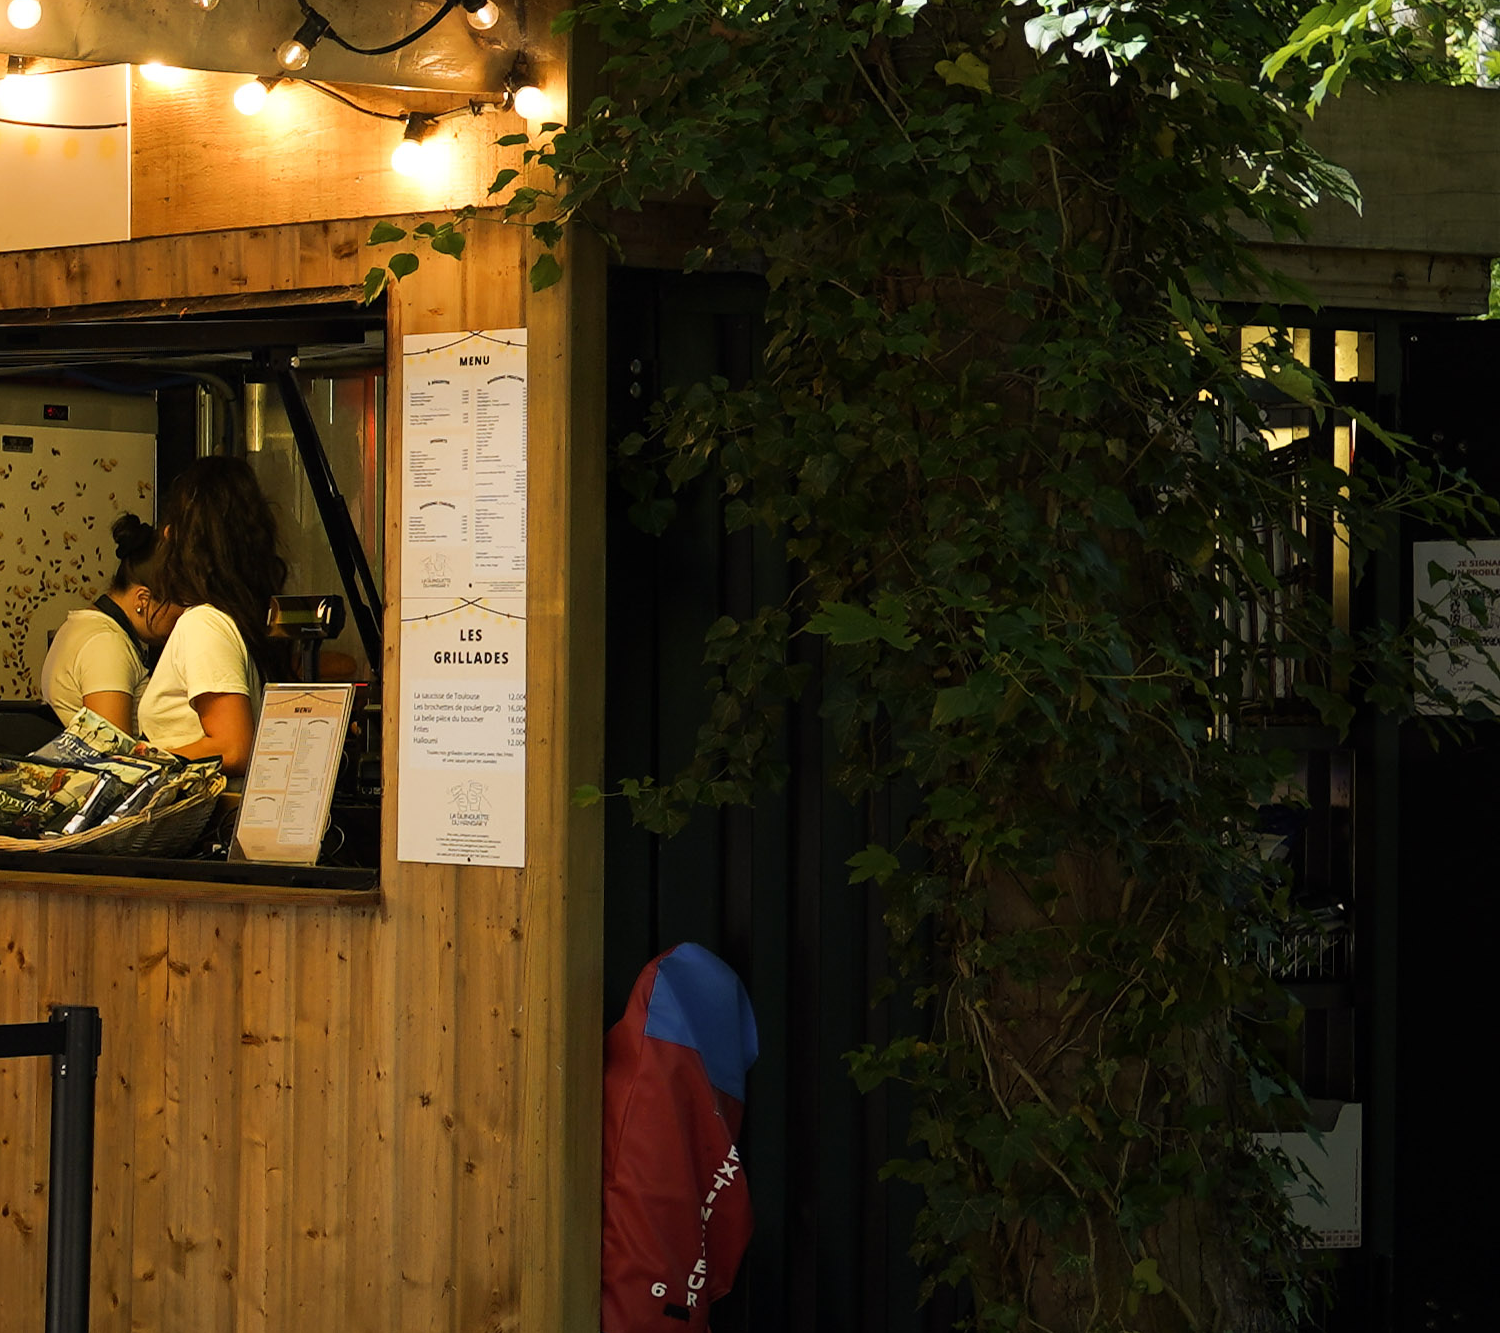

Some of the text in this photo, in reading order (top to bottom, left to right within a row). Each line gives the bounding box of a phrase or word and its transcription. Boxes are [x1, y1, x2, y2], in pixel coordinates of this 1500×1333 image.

[460, 356, 490, 366] MENU
[460, 629, 483, 642] LES
[434, 651, 509, 664] GRILLADES
[413, 703, 423, 711] Les
[454, 703, 462, 711] de
[463, 703, 482, 712] poulet
[413, 714, 421, 722] La
[421, 714, 435, 722] belle
[451, 714, 460, 722] du
[460, 715, 484, 723] boucher
[686, 1144, 740, 1307] EXTINEUR
[651, 1282, 668, 1297] 6
